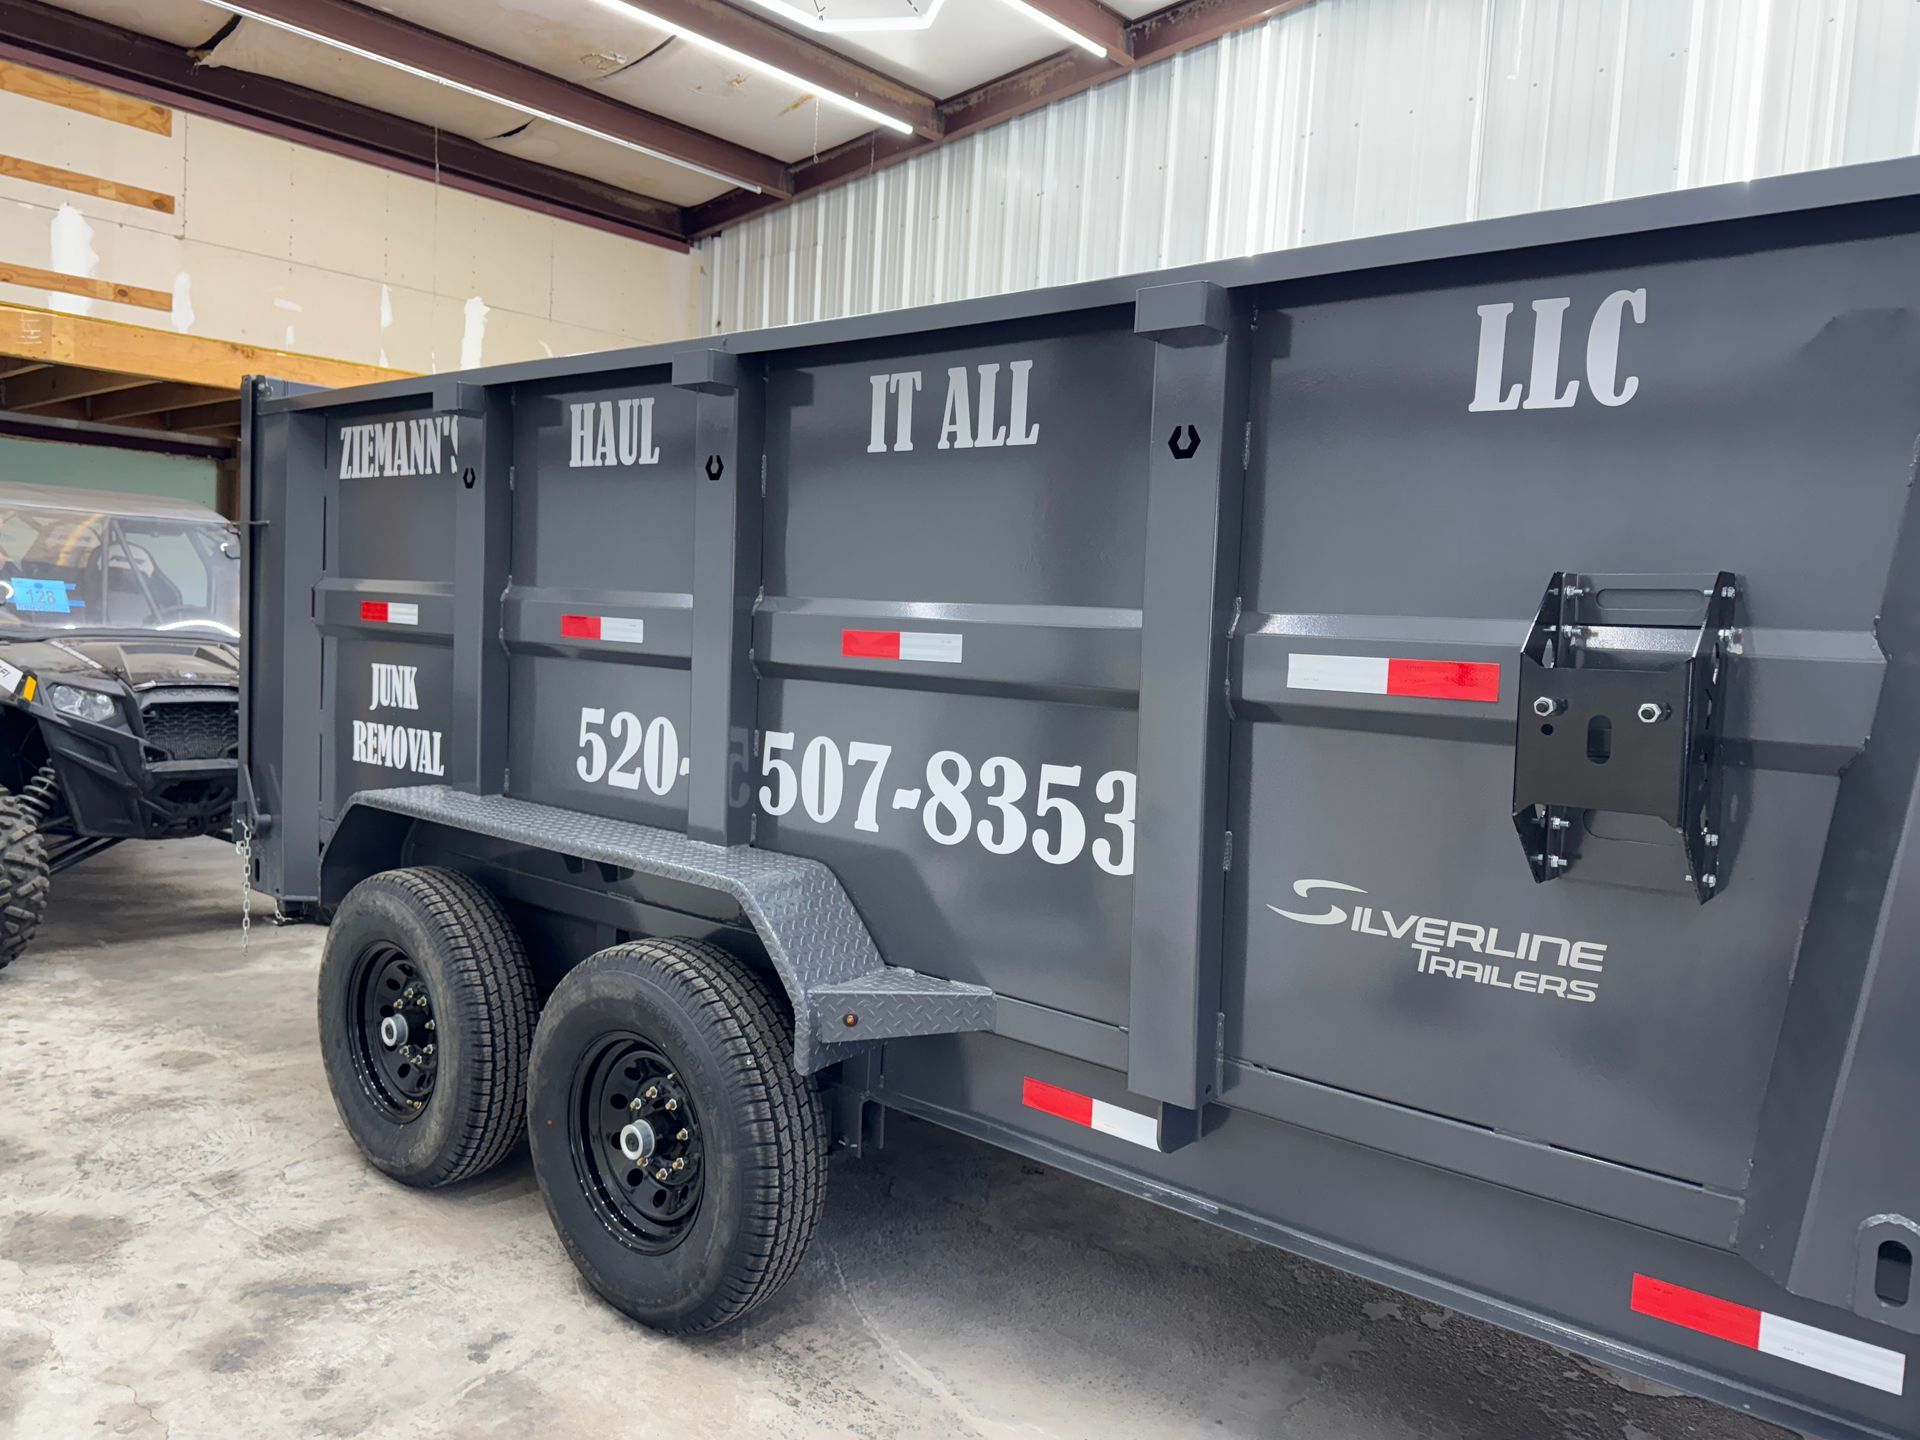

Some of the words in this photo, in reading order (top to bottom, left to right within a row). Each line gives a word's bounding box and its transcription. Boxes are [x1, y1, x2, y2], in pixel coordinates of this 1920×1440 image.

[569, 397, 660, 468] HAUL
[867, 371, 922, 453] IT
[937, 359, 1040, 450] ALL
[1468, 288, 1647, 413] LLC
[26, 588, 56, 604] 128
[369, 662, 419, 711] JUNK
[352, 720, 445, 777] REMOVAL
[758, 730, 1137, 876] 507-8353
[1266, 879, 1608, 972] SILVERLINE
[1411, 942, 1600, 1003] TRAILERS
